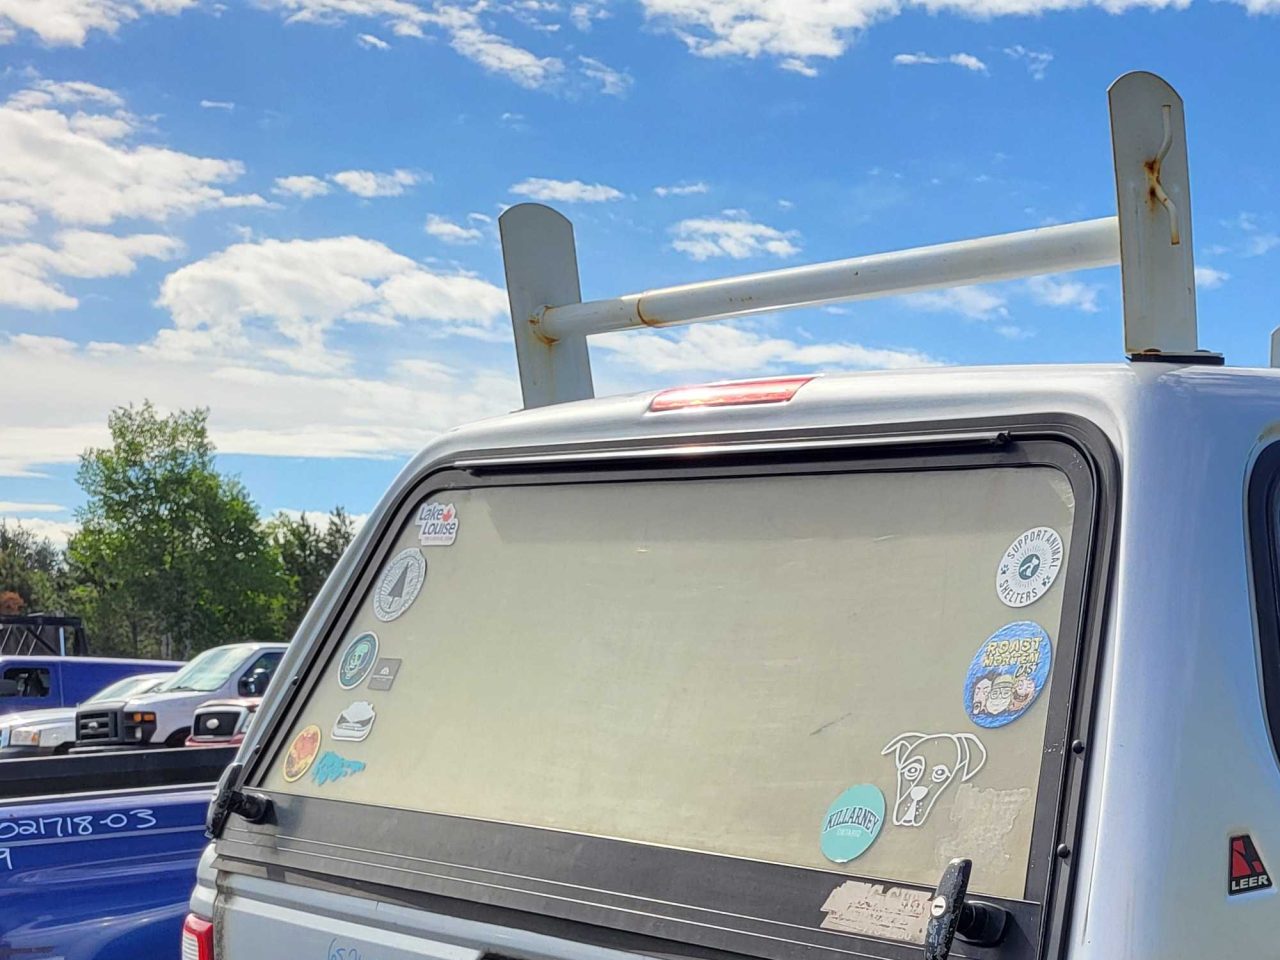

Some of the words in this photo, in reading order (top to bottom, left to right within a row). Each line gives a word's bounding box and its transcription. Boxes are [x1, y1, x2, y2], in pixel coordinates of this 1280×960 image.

[419, 505, 444, 521] Lake
[422, 522, 456, 536] Louise
[1007, 529, 1048, 559] SUPPORT
[1046, 533, 1061, 569] ANIMAL
[1000, 579, 1038, 604] SHELTERS
[987, 636, 1043, 656] ROAST
[983, 652, 1040, 668] MORTEM
[824, 806, 880, 835] KILLARNEY
[1231, 874, 1269, 891] LEER
